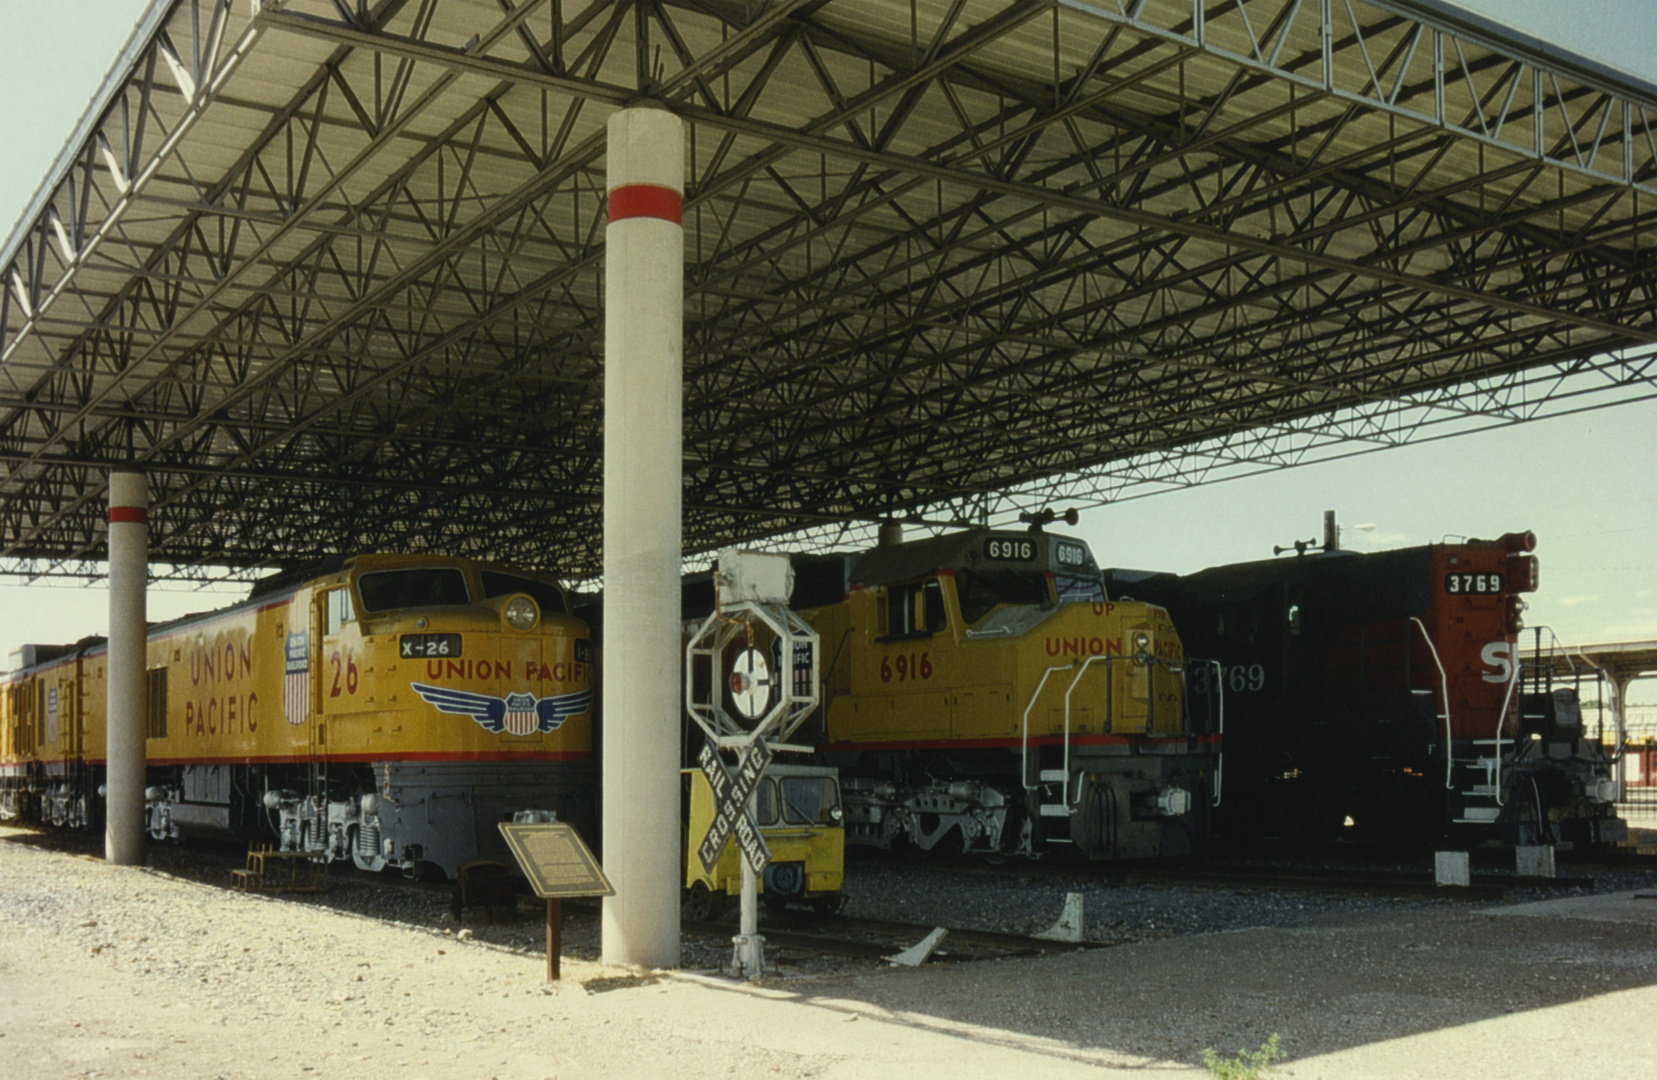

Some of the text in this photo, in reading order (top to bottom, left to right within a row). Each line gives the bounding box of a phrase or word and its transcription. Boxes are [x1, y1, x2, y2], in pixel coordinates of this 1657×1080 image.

[989, 541, 1031, 558] 6916
[1058, 545, 1083, 566] 6916
[1449, 575, 1500, 592] 3769
[1092, 602, 1115, 616] UP
[402, 641, 449, 656] X-26
[1046, 637, 1122, 657] UNION
[191, 637, 252, 686] UNION
[329, 648, 358, 698] 26
[427, 659, 592, 684] UNION PACIFIC
[881, 652, 933, 683] 6916
[1194, 664, 1264, 694] 3769
[186, 692, 258, 737] PACIFIC
[698, 744, 766, 872] RAIL ROAD
[701, 746, 764, 864] CROSSING
